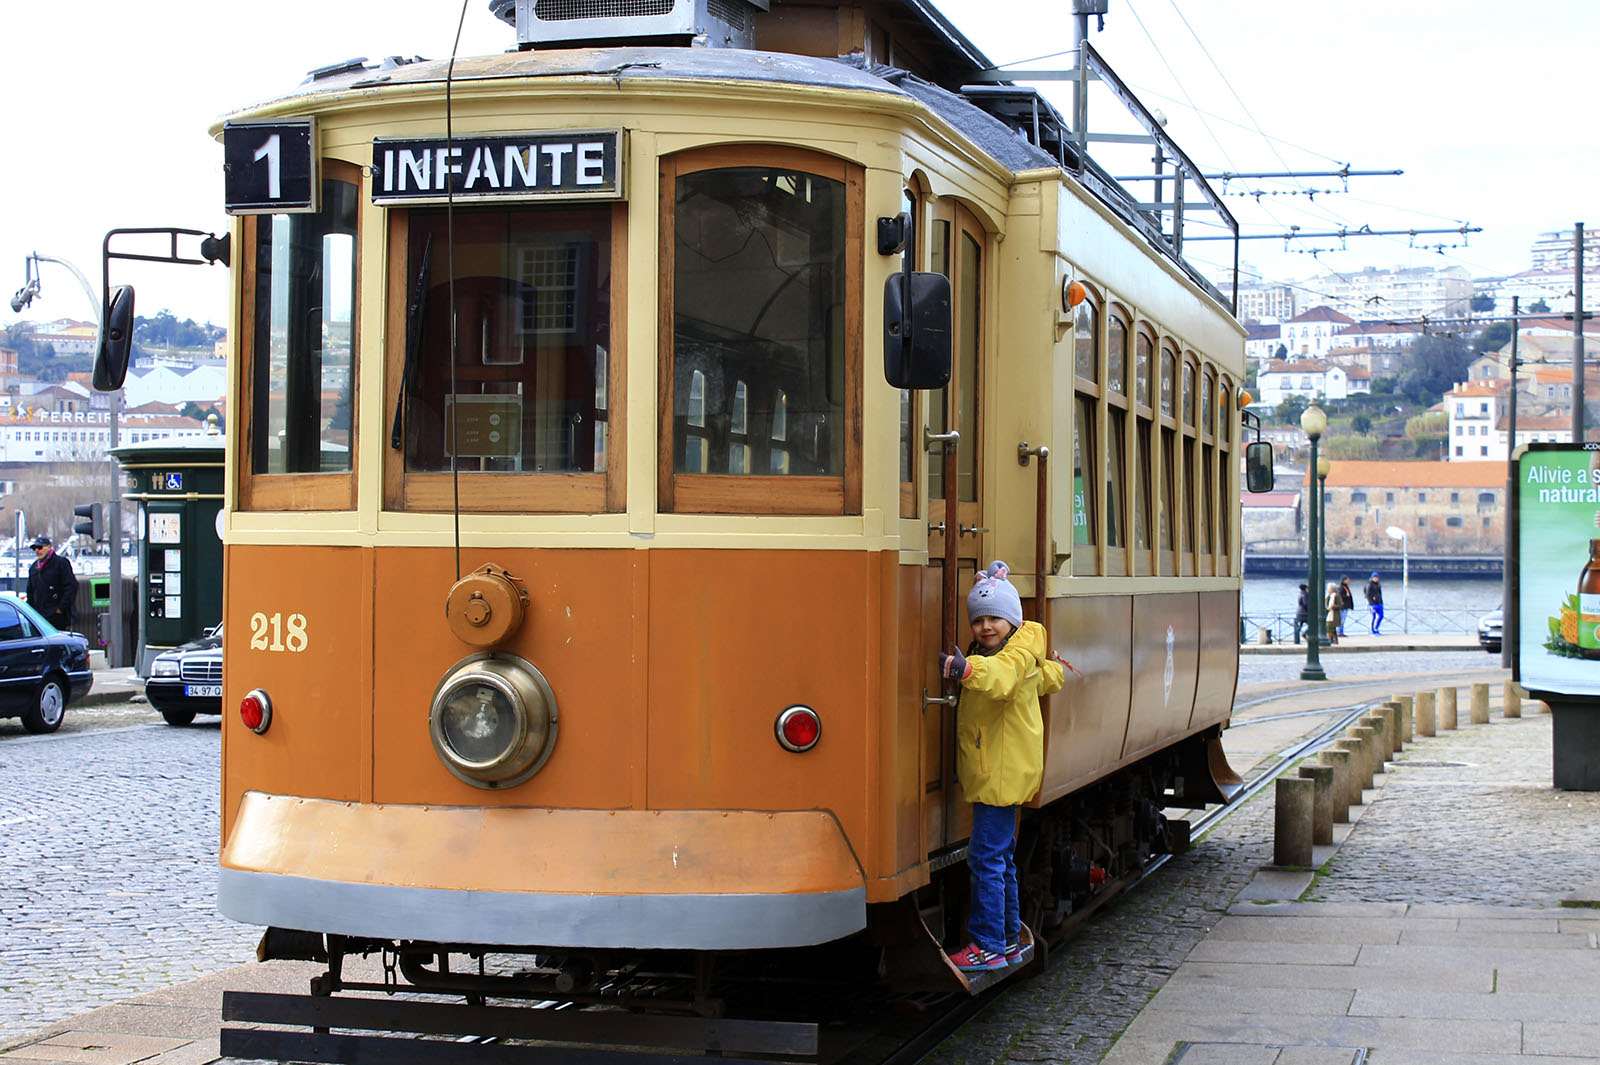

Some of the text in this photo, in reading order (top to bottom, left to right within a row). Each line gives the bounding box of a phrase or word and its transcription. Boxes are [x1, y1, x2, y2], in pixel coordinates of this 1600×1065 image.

[253, 133, 281, 199] 1
[383, 142, 604, 192] INFANTE
[1527, 465, 1572, 484] Alivie
[1577, 468, 1588, 484] a
[250, 612, 309, 653] 218
